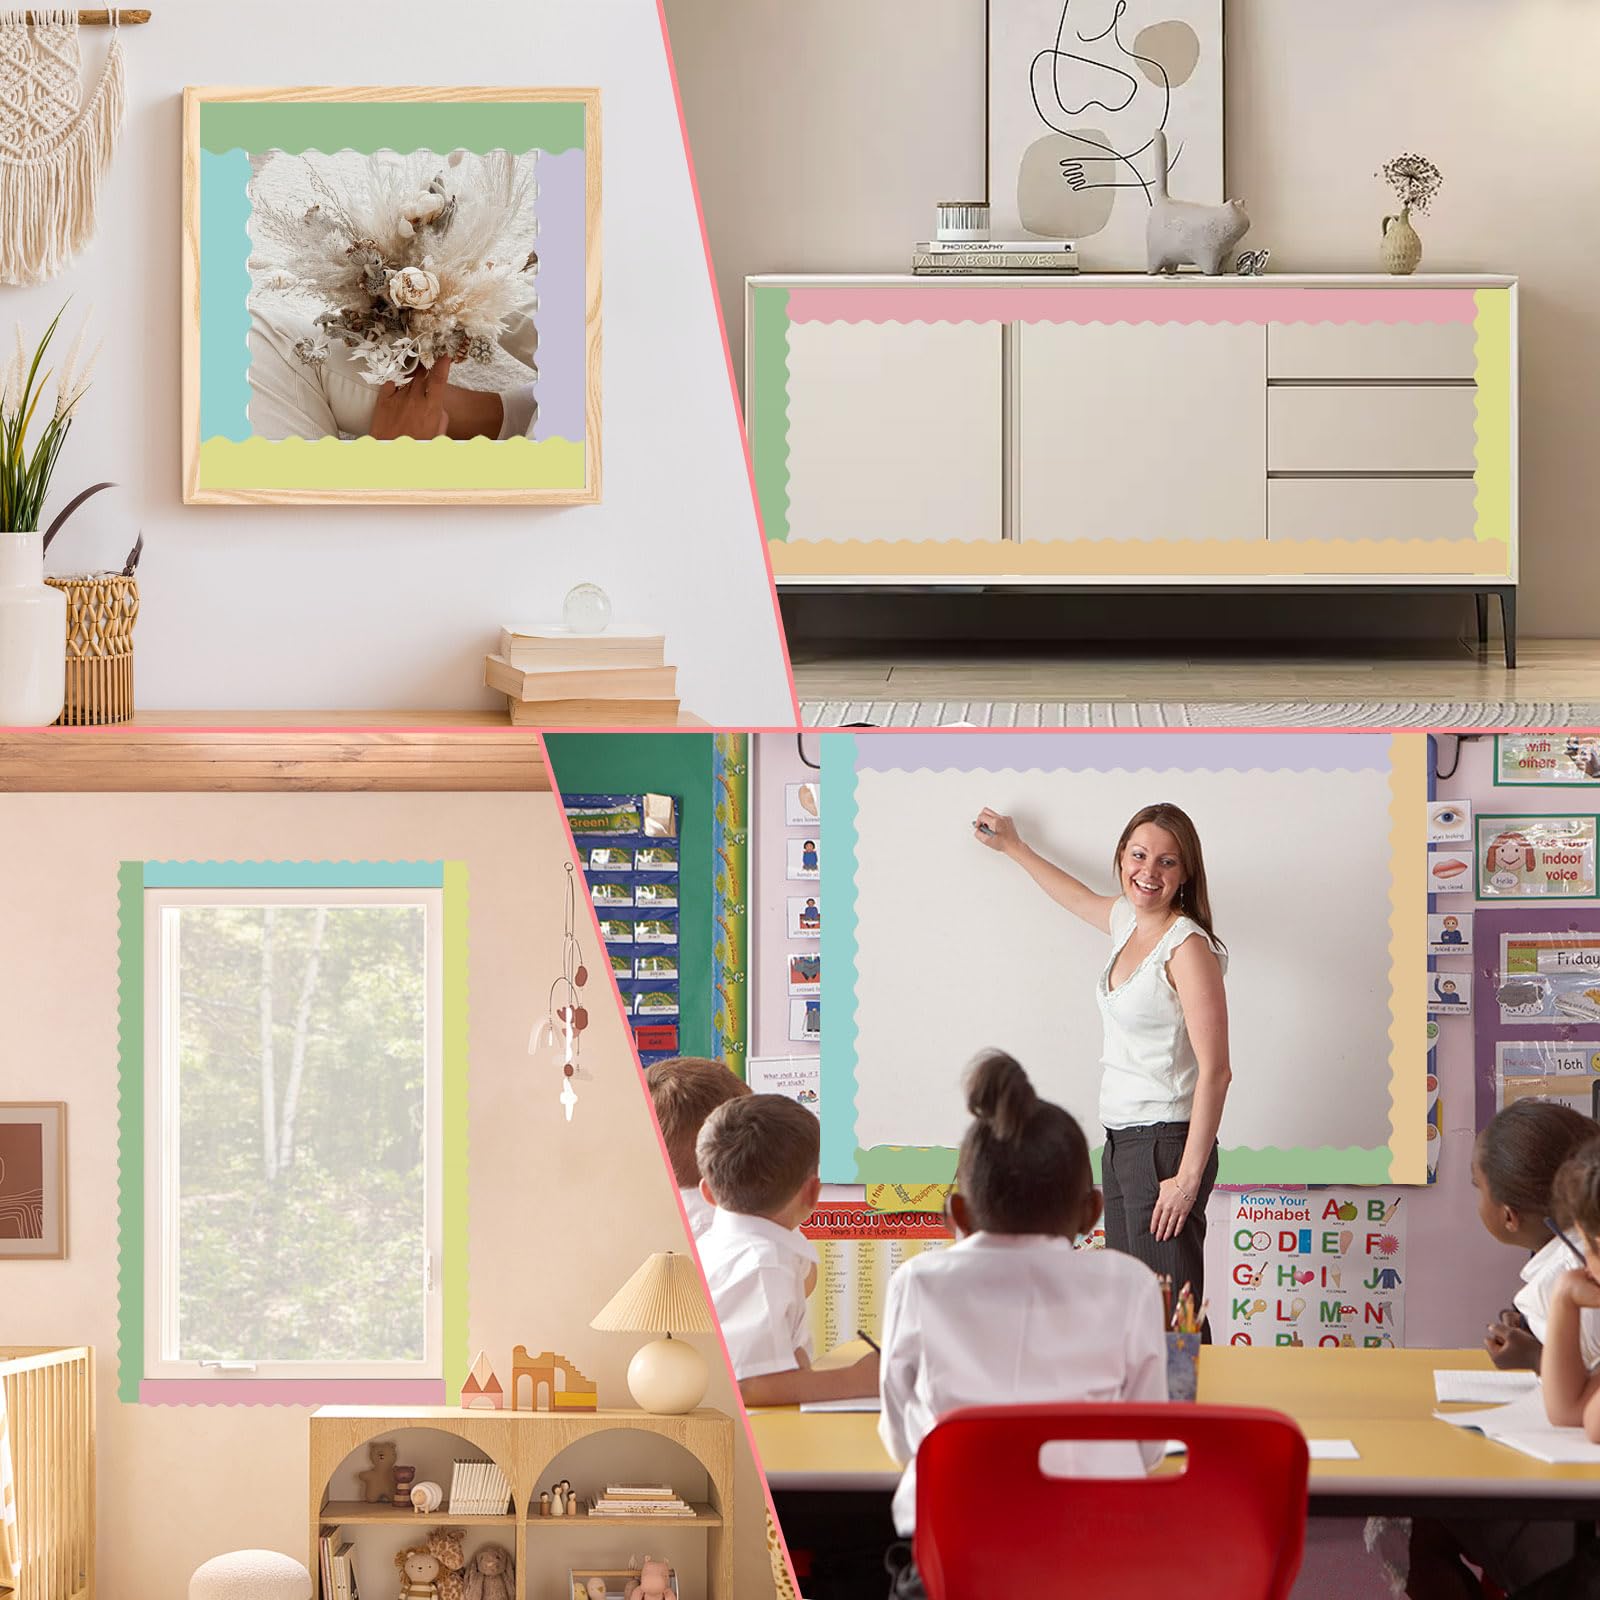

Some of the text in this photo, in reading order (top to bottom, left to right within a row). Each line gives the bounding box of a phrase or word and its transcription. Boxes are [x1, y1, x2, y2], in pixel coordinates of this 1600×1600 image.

[918, 255, 1056, 266] ALL ABOUT YVES
[1525, 740, 1551, 752] with
[1518, 756, 1557, 768] others
[570, 817, 609, 828] Green!
[1542, 852, 1583, 864] indoor
[1545, 869, 1578, 881] voice
[1557, 951, 1600, 968] Friday
[1557, 1058, 1584, 1070] 16th
[1240, 1194, 1308, 1206] Know Your
[1236, 1206, 1311, 1223] Alphabet
[1321, 1198, 1385, 1221] A B
[800, 1211, 878, 1227] ommon
[1233, 1229, 1382, 1255] C D E F
[1233, 1263, 1253, 1285] G
[1277, 1264, 1297, 1286] H
[1363, 1267, 1379, 1289] J
[1232, 1298, 1384, 1324] K L M N
